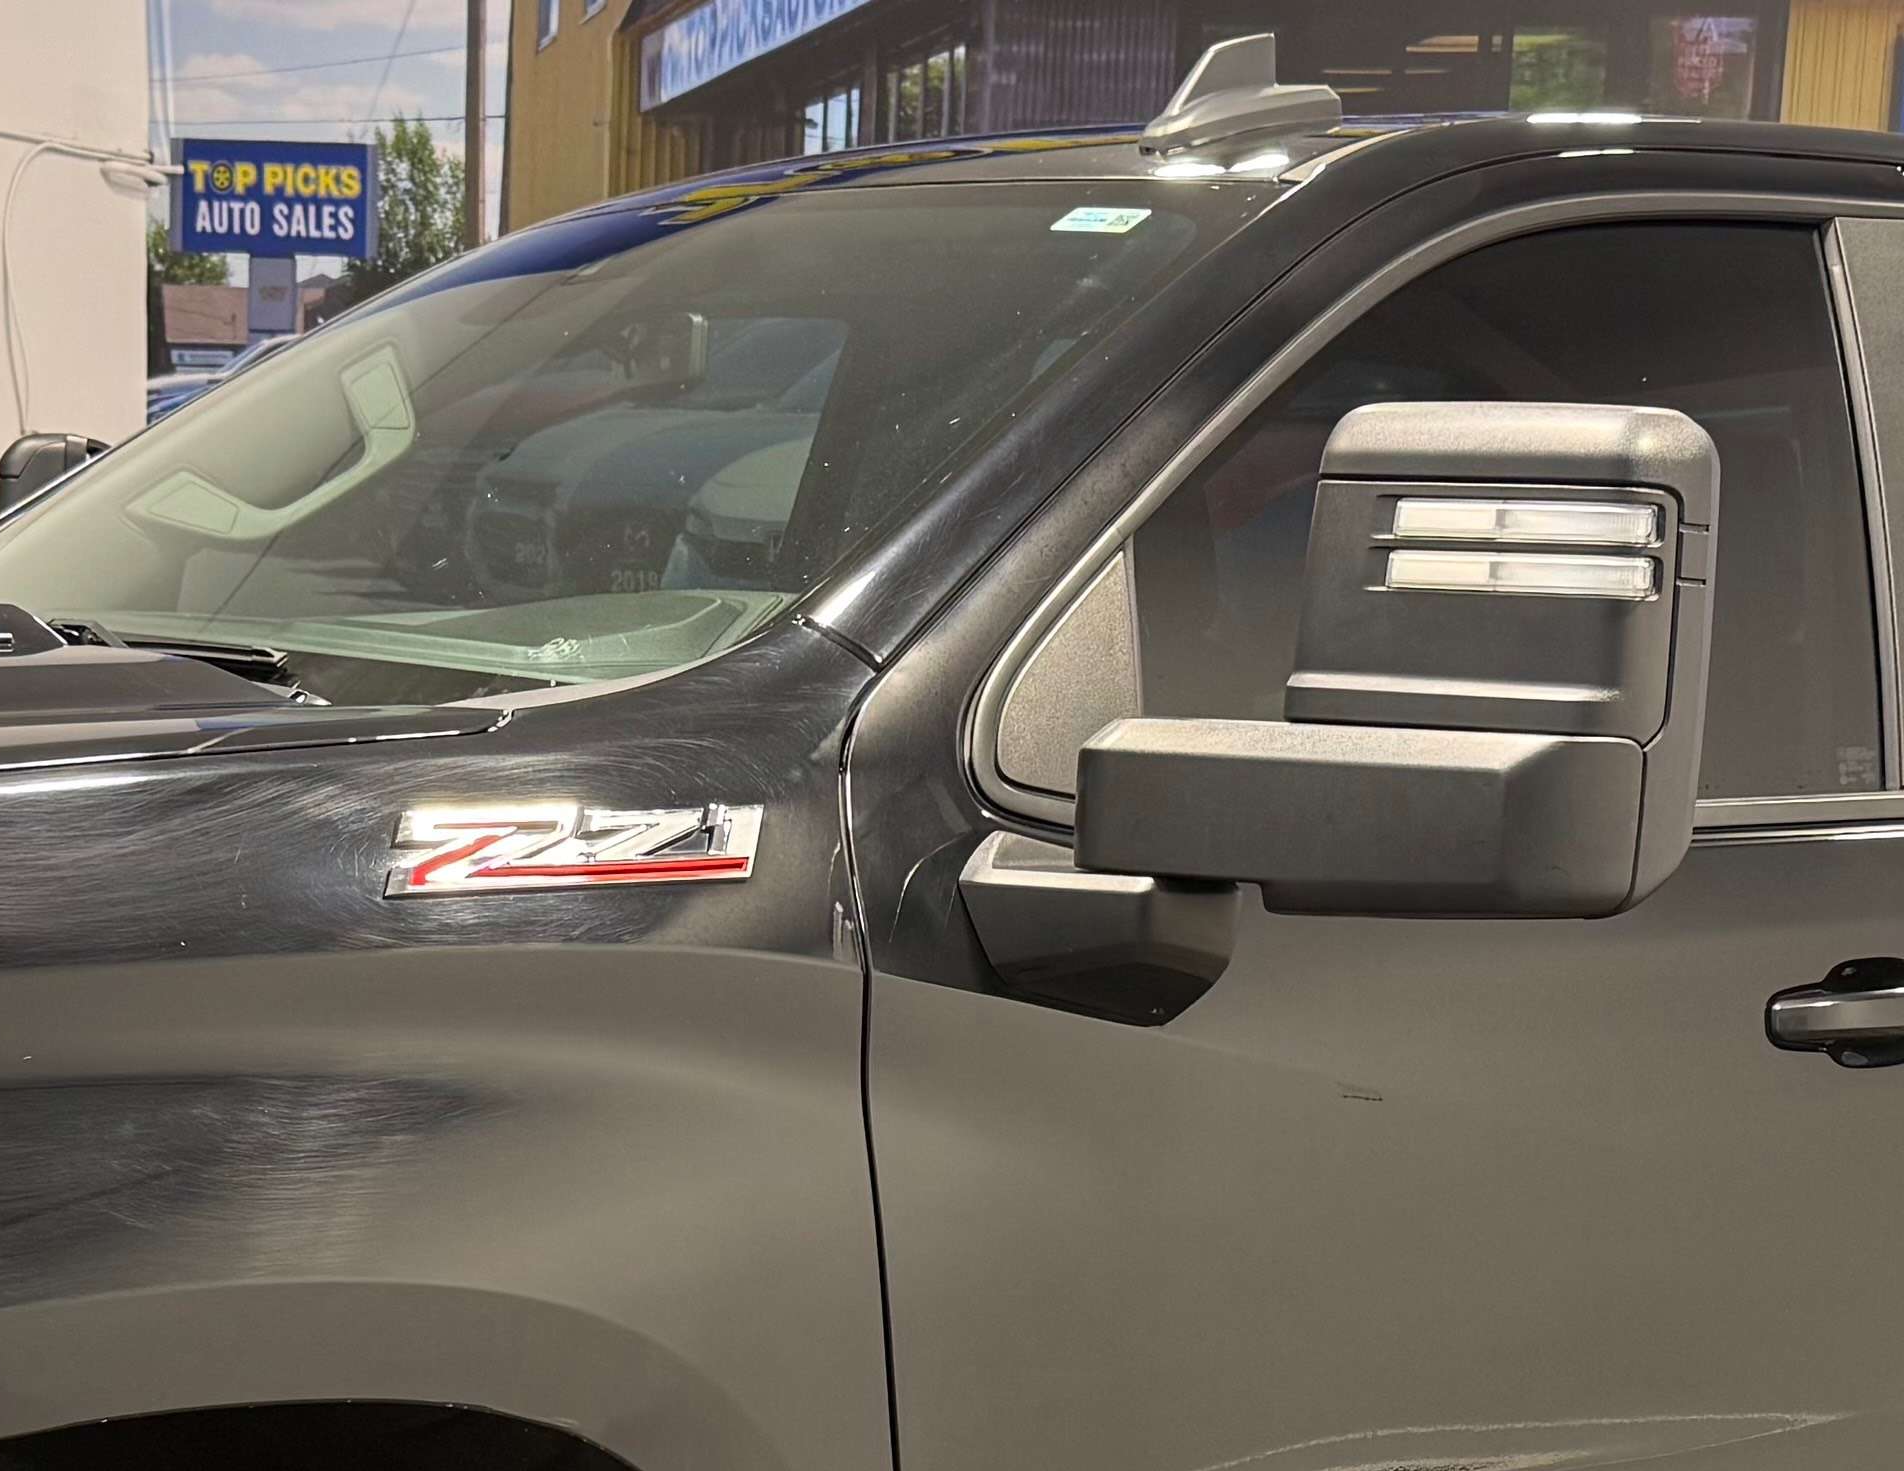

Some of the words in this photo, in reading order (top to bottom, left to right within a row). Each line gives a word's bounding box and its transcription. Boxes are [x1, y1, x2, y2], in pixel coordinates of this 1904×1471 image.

[188, 160, 257, 194] TOP
[263, 164, 361, 199] PICKS
[197, 201, 261, 235] AUTO
[273, 203, 354, 240] SALES
[384, 802, 764, 899] Z71
